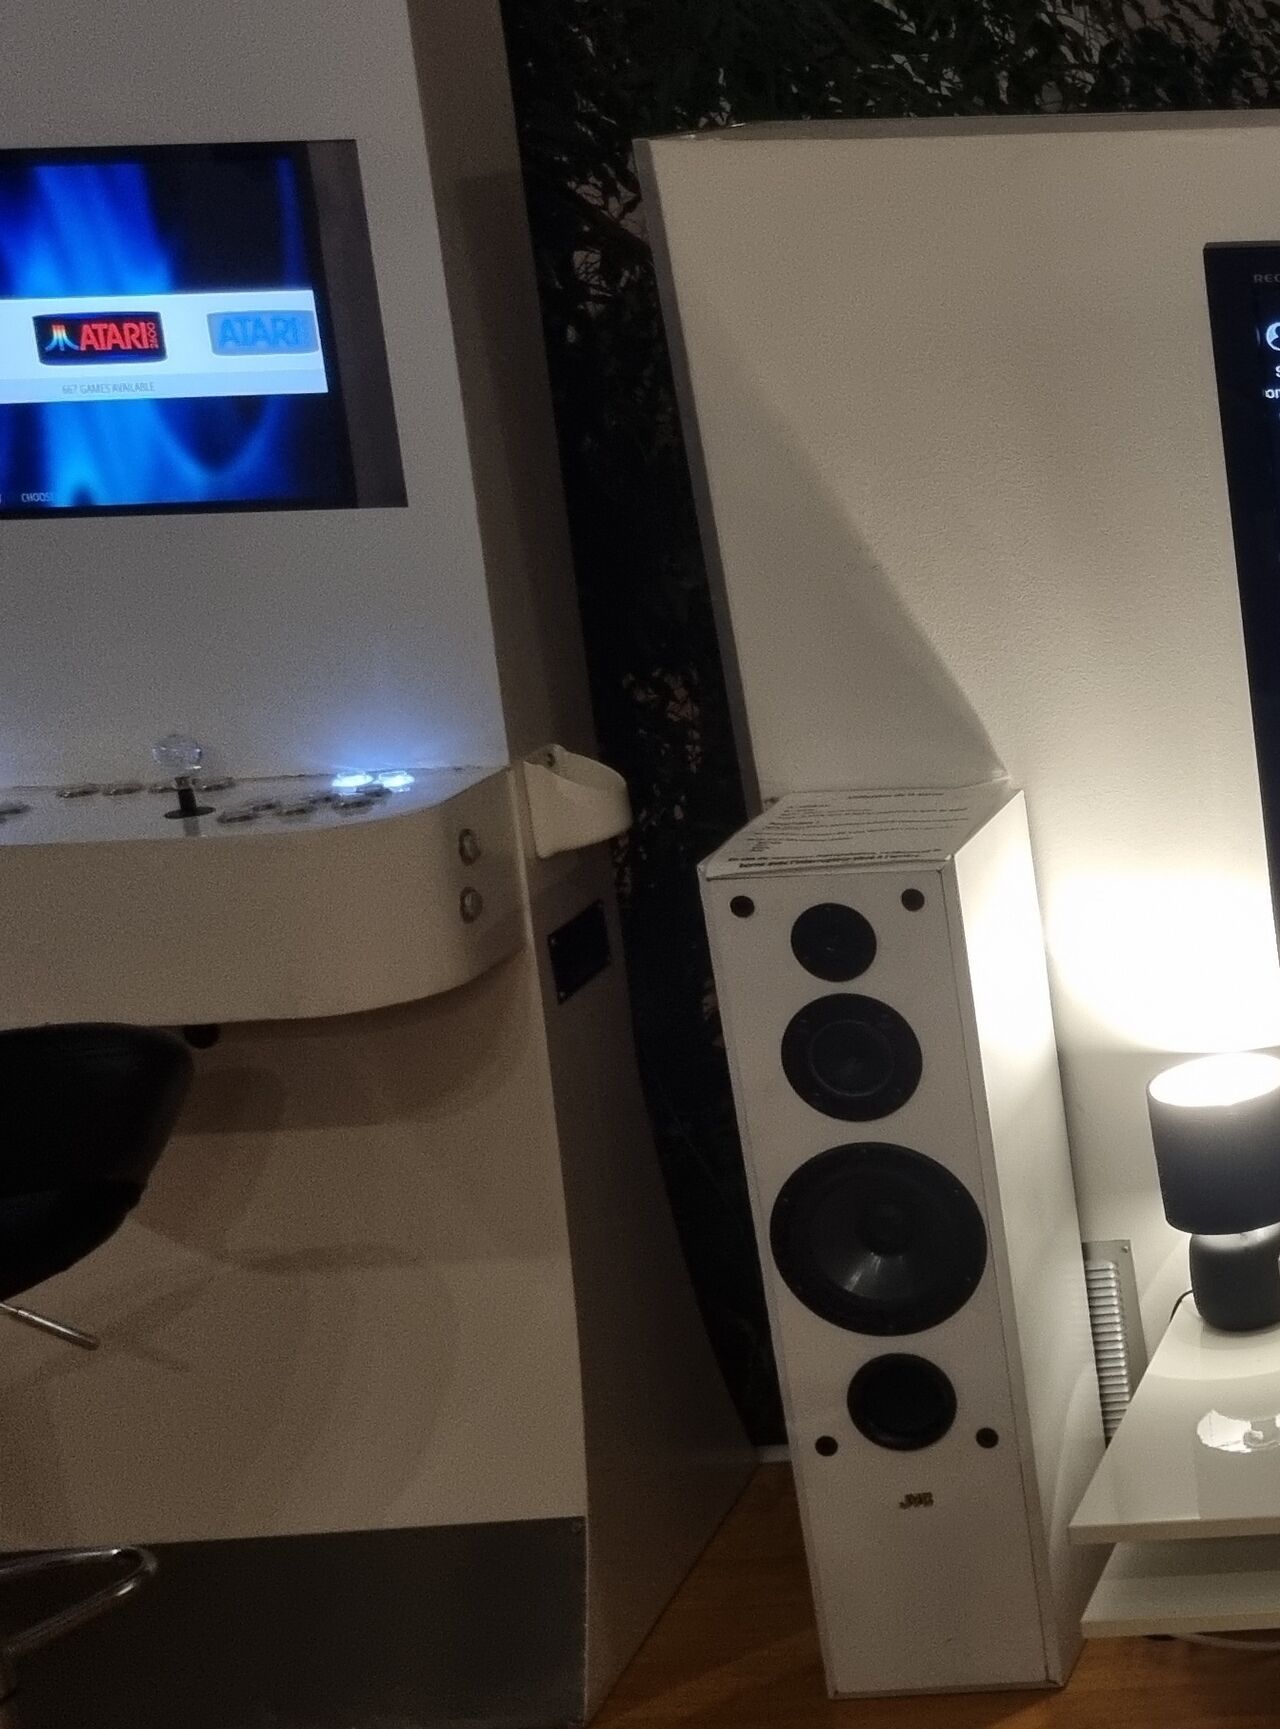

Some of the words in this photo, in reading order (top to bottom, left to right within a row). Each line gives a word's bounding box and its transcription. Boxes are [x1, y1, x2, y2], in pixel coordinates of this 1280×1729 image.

[79, 321, 150, 351] ATARI
[218, 317, 299, 347] ATARI
[80, 383, 111, 394] GAMES
